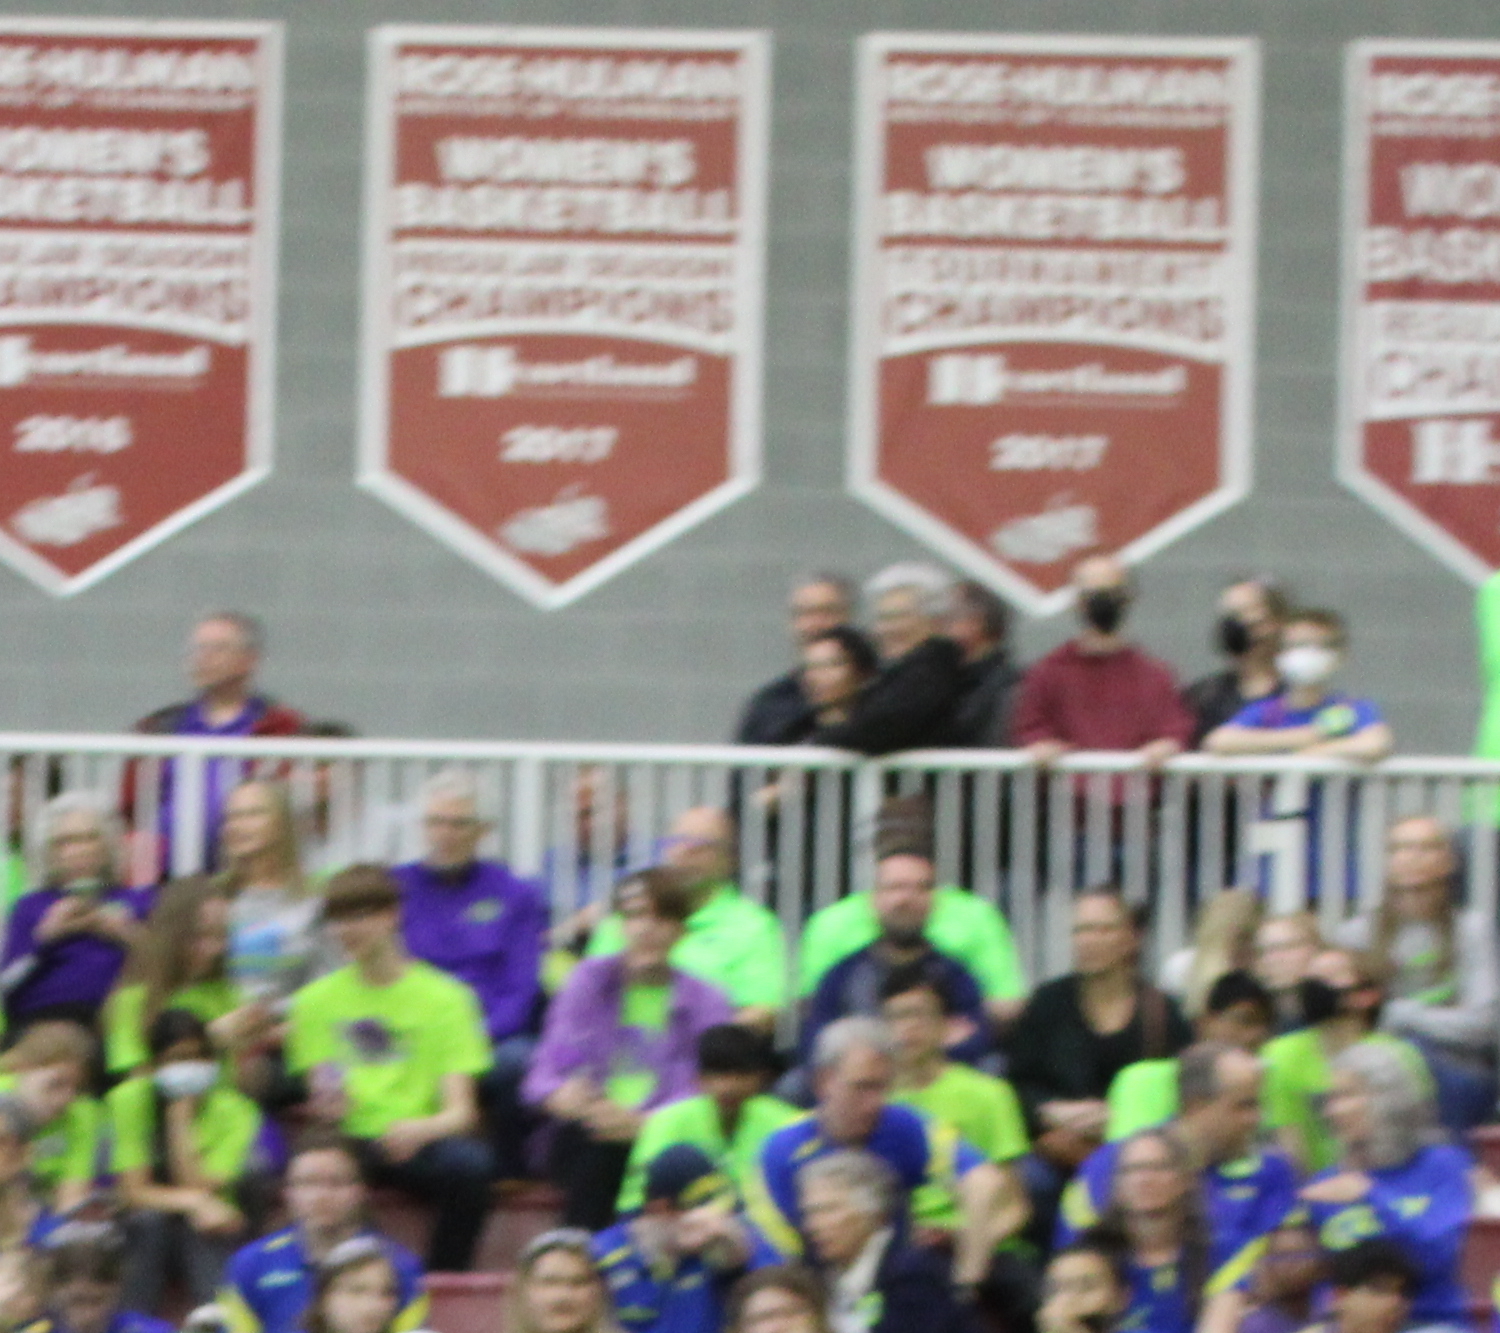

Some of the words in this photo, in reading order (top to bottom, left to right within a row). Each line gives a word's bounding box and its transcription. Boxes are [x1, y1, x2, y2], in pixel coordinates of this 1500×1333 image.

[438, 137, 694, 184] WOMEN'S
[929, 144, 1183, 193] WOMEN'S
[396, 184, 735, 233] BASKETBALL
[885, 192, 1225, 241] BASKETBALL
[401, 282, 732, 332] CHAMPIONS
[891, 291, 1220, 341] CHAMPIONS
[502, 426, 617, 463] 2017
[990, 435, 1107, 471] 2017
